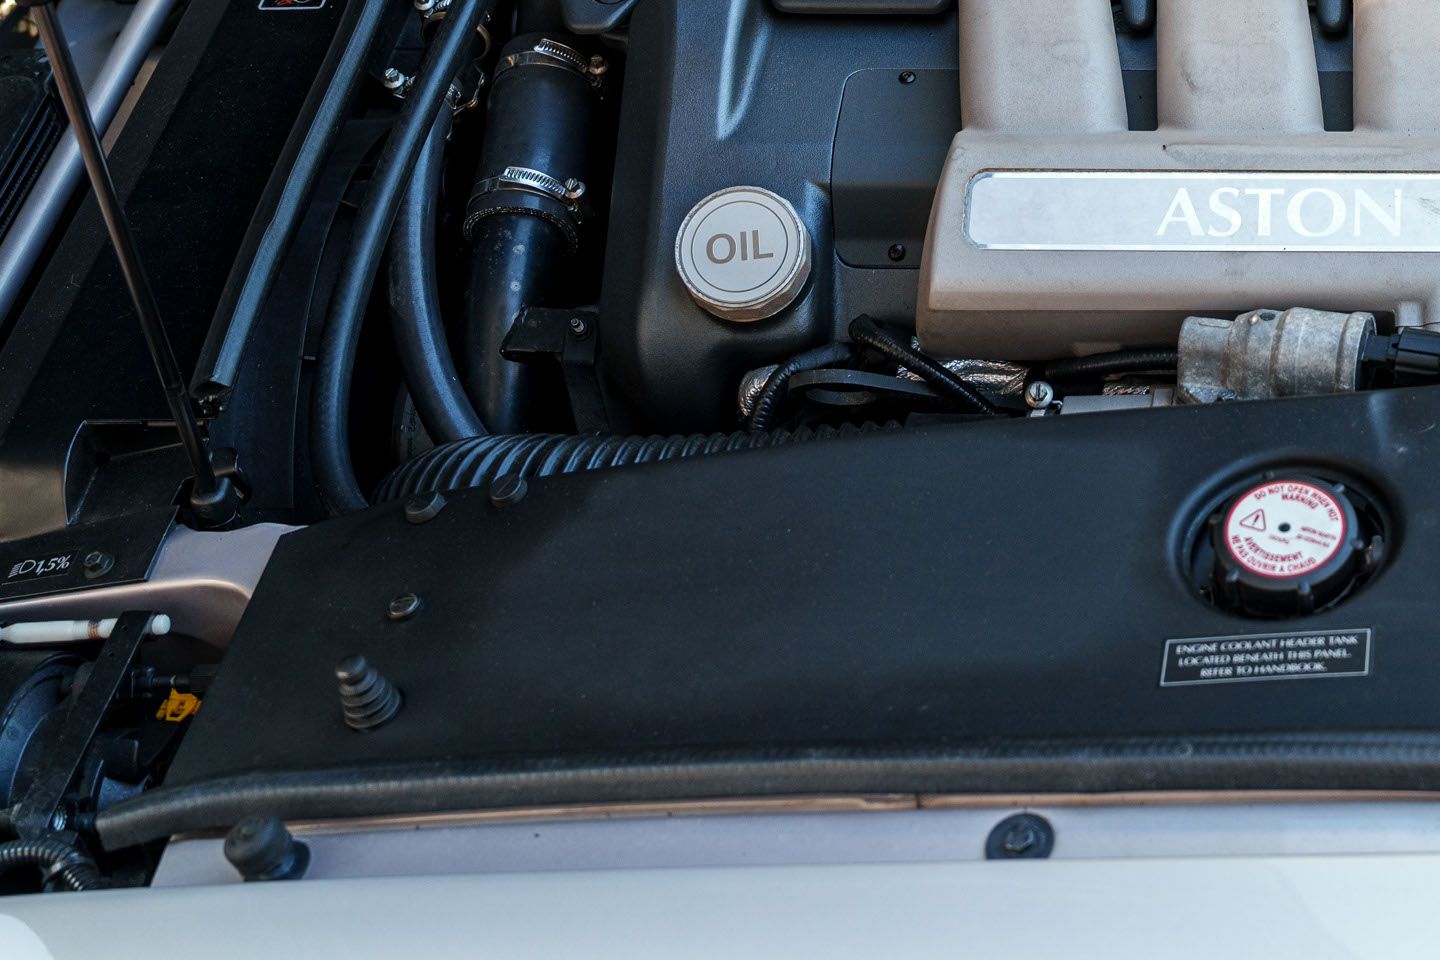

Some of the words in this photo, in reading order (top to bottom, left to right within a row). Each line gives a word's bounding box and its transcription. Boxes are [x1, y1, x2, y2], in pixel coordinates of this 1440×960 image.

[1155, 186, 1403, 238] ASTON
[705, 228, 775, 266] OIL
[1254, 491, 1267, 500] DO
[1267, 485, 1284, 494] NOT
[1287, 485, 1309, 495] OPEN
[1311, 492, 1331, 508] WHEN
[1328, 508, 1339, 521] HOT
[1281, 493, 1319, 510] WARNING
[1231, 534, 1241, 545] NE
[1236, 544, 1249, 559] PAS
[1247, 557, 1277, 572] OUVRIR
[1287, 556, 1317, 572] CHAUD
[1244, 536, 1303, 562] AVERTISSEMENT
[35, 553, 71, 576] 1,5%
[1176, 642, 1219, 656] ENGINE
[1220, 639, 1277, 653] COOLANT
[1280, 635, 1326, 649] HEADER
[1329, 634, 1359, 647] TANK
[1178, 653, 1232, 668] LOCATED
[1232, 651, 1284, 664] BENEATH
[1287, 649, 1312, 660] THIS
[1313, 647, 1352, 659] PANEL.
[1200, 666, 1233, 678] REFER
[1236, 665, 1253, 676] TO
[1253, 660, 1327, 676] HANDBOOK.
